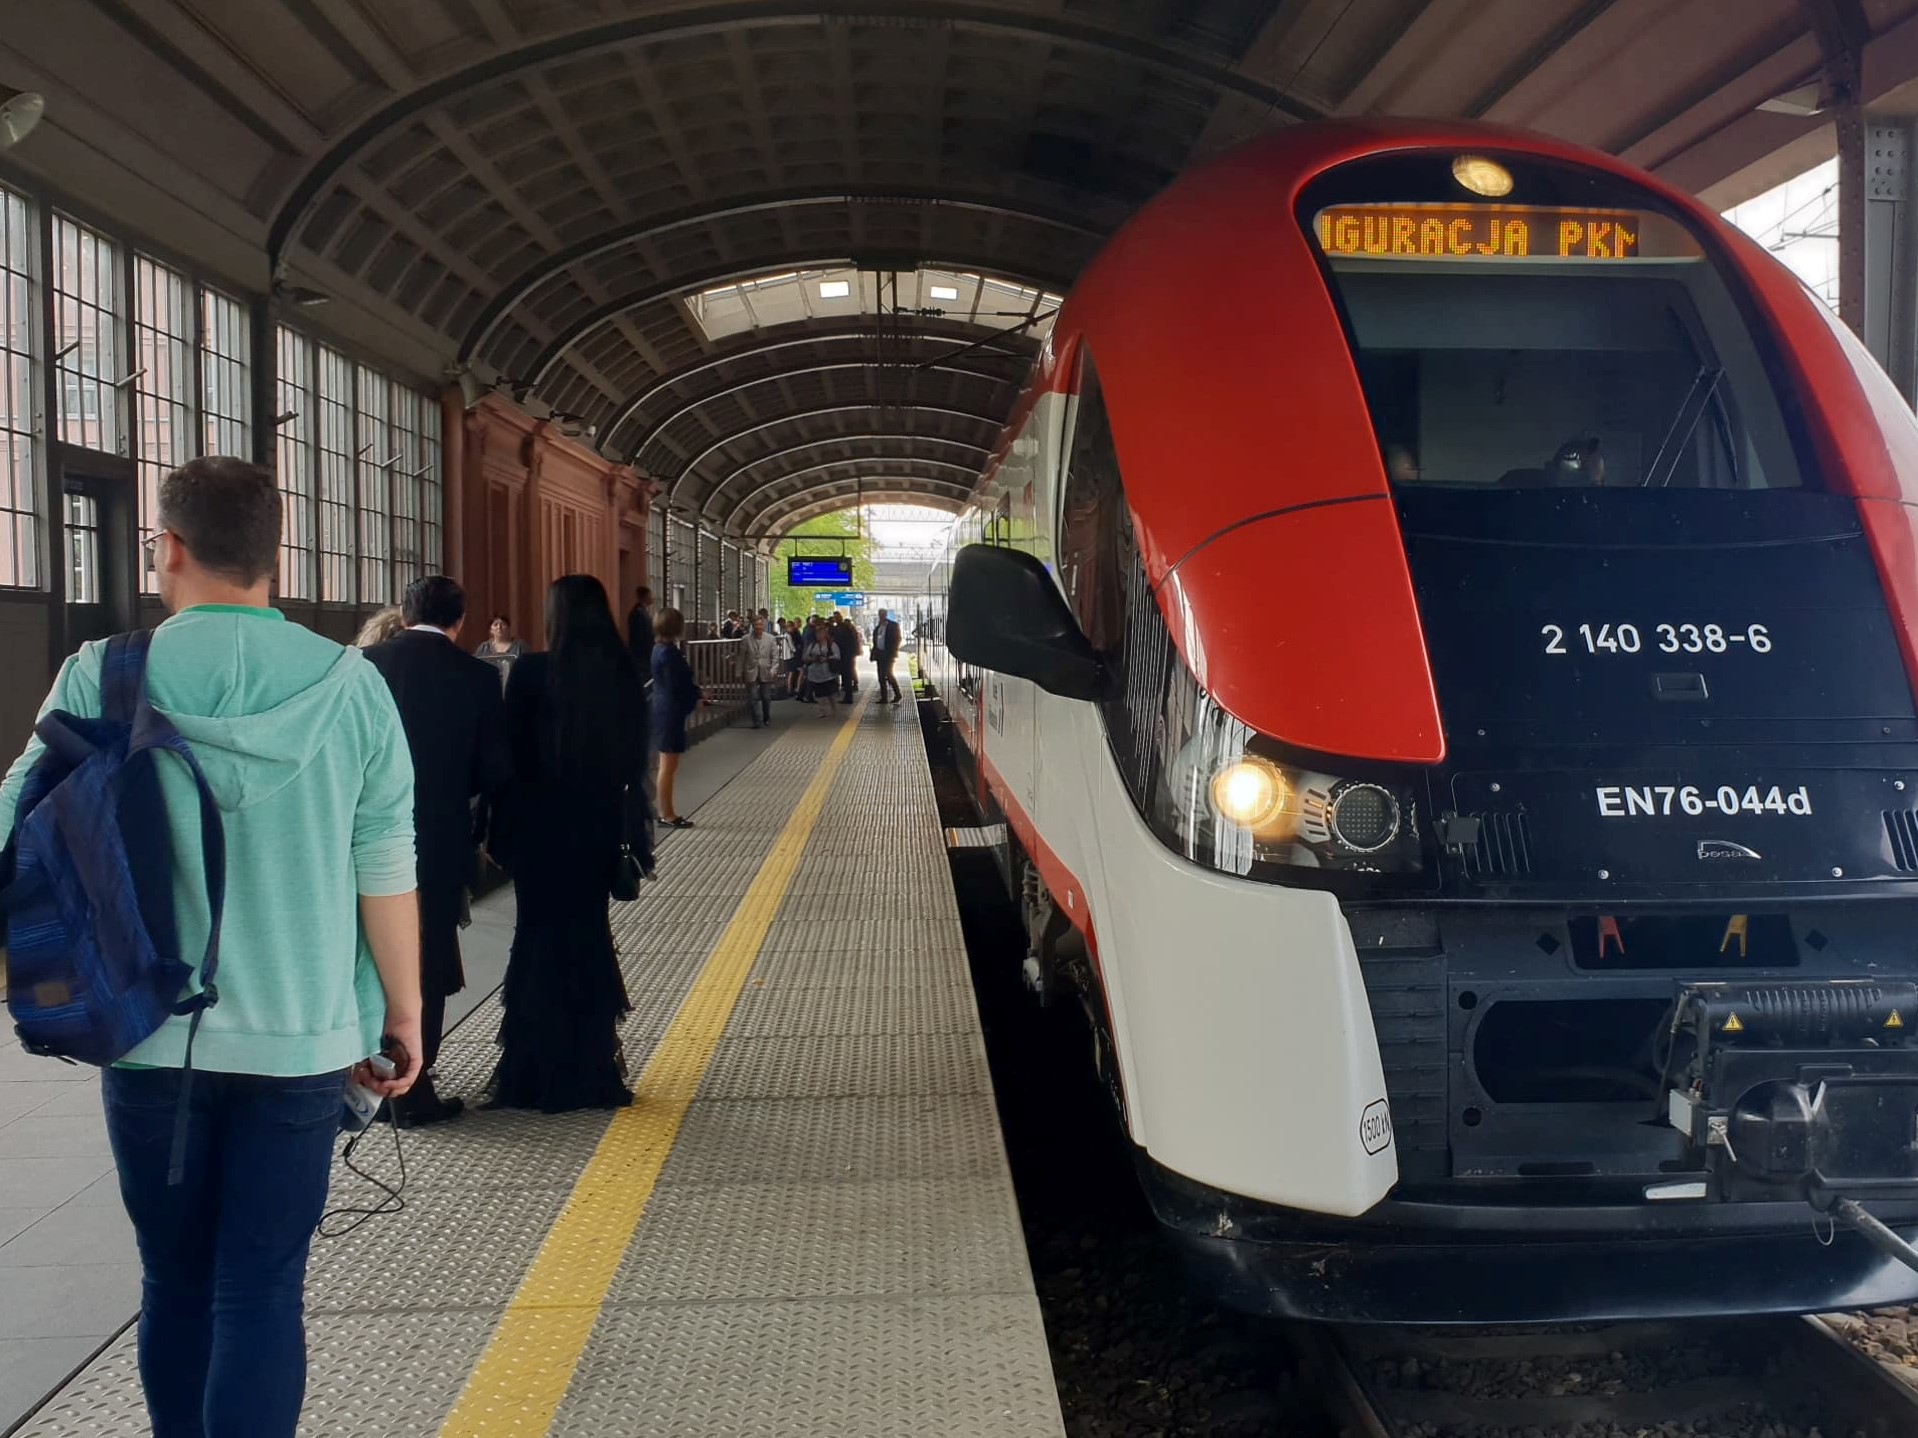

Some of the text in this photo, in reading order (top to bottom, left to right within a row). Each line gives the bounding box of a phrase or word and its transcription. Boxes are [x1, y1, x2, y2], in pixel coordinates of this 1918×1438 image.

[1541, 623, 1772, 654] 2 140 338-6
[1596, 785, 1812, 816] EN76-044d
